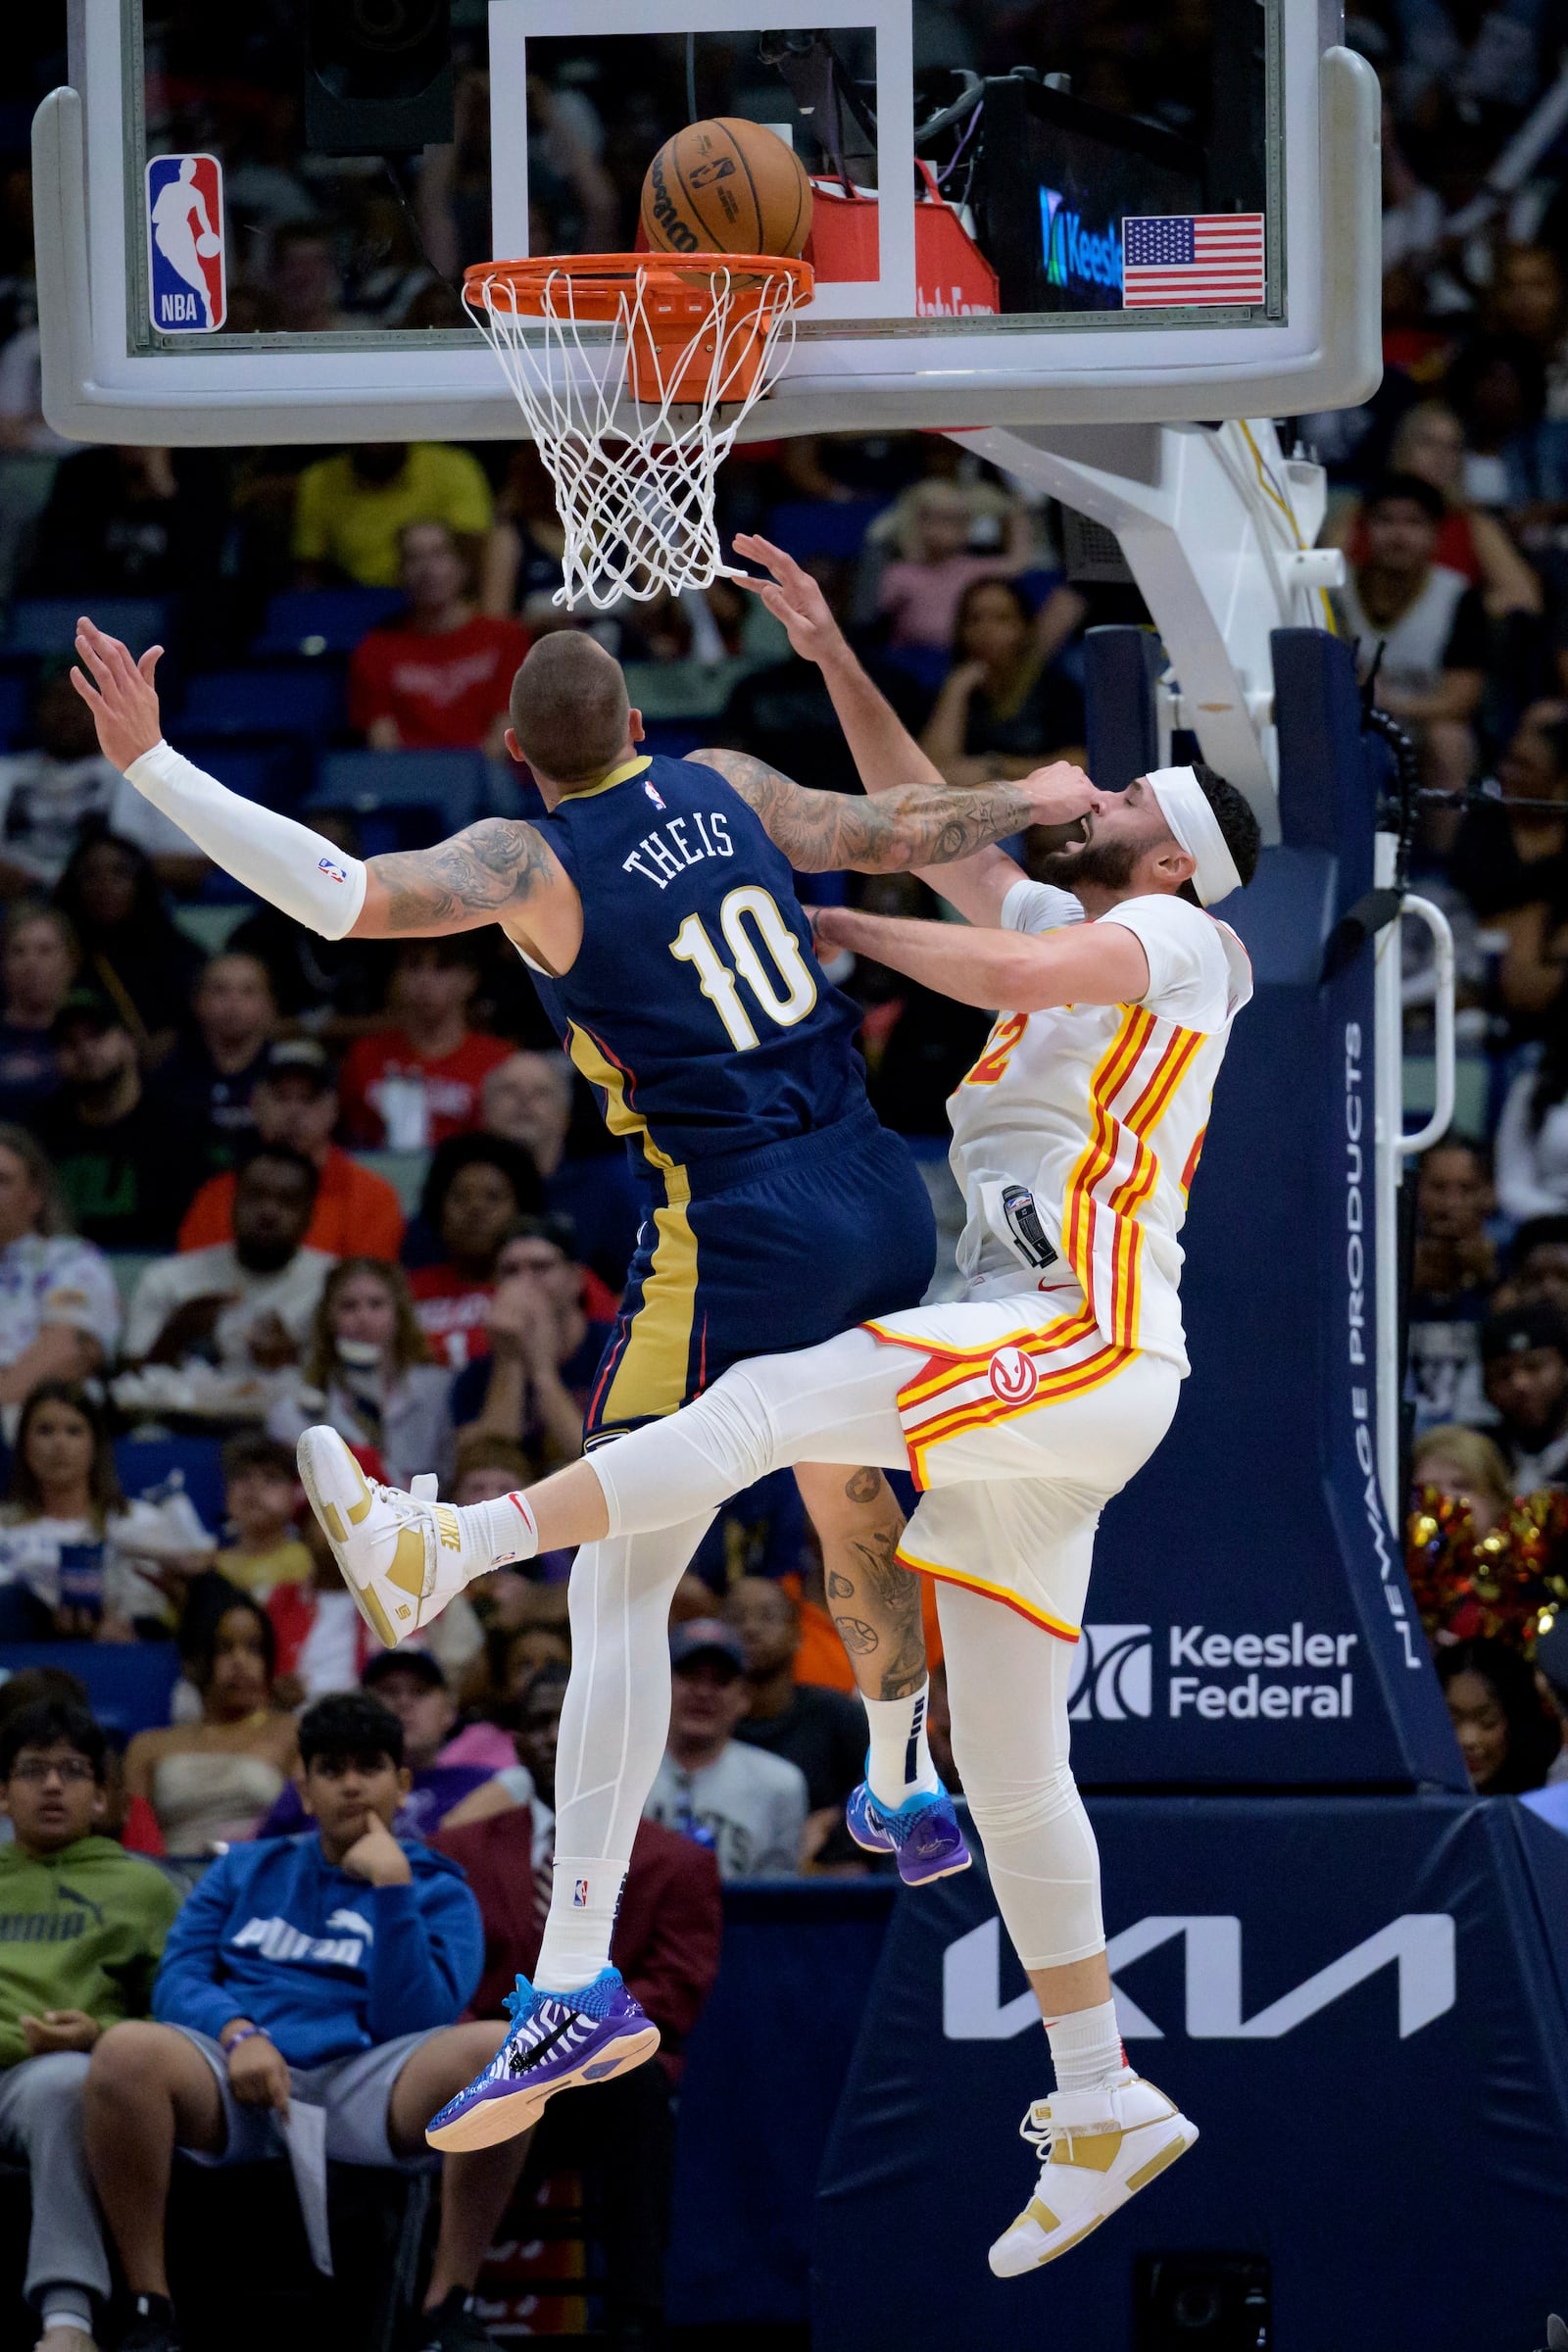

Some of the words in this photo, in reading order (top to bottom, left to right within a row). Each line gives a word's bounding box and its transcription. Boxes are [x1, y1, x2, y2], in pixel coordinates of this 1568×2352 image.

[1066, 211, 1123, 291] Keesle
[161, 294, 198, 322] NBA
[622, 811, 734, 890] THEIS
[667, 884, 817, 1053] 10
[955, 1011, 1030, 1096] 2
[1345, 1022, 1365, 1365] PRODUCTS
[431, 1505, 461, 1552] NIKE
[1169, 1621, 1358, 1668] Keesler
[1169, 1672, 1353, 1719] Federal
